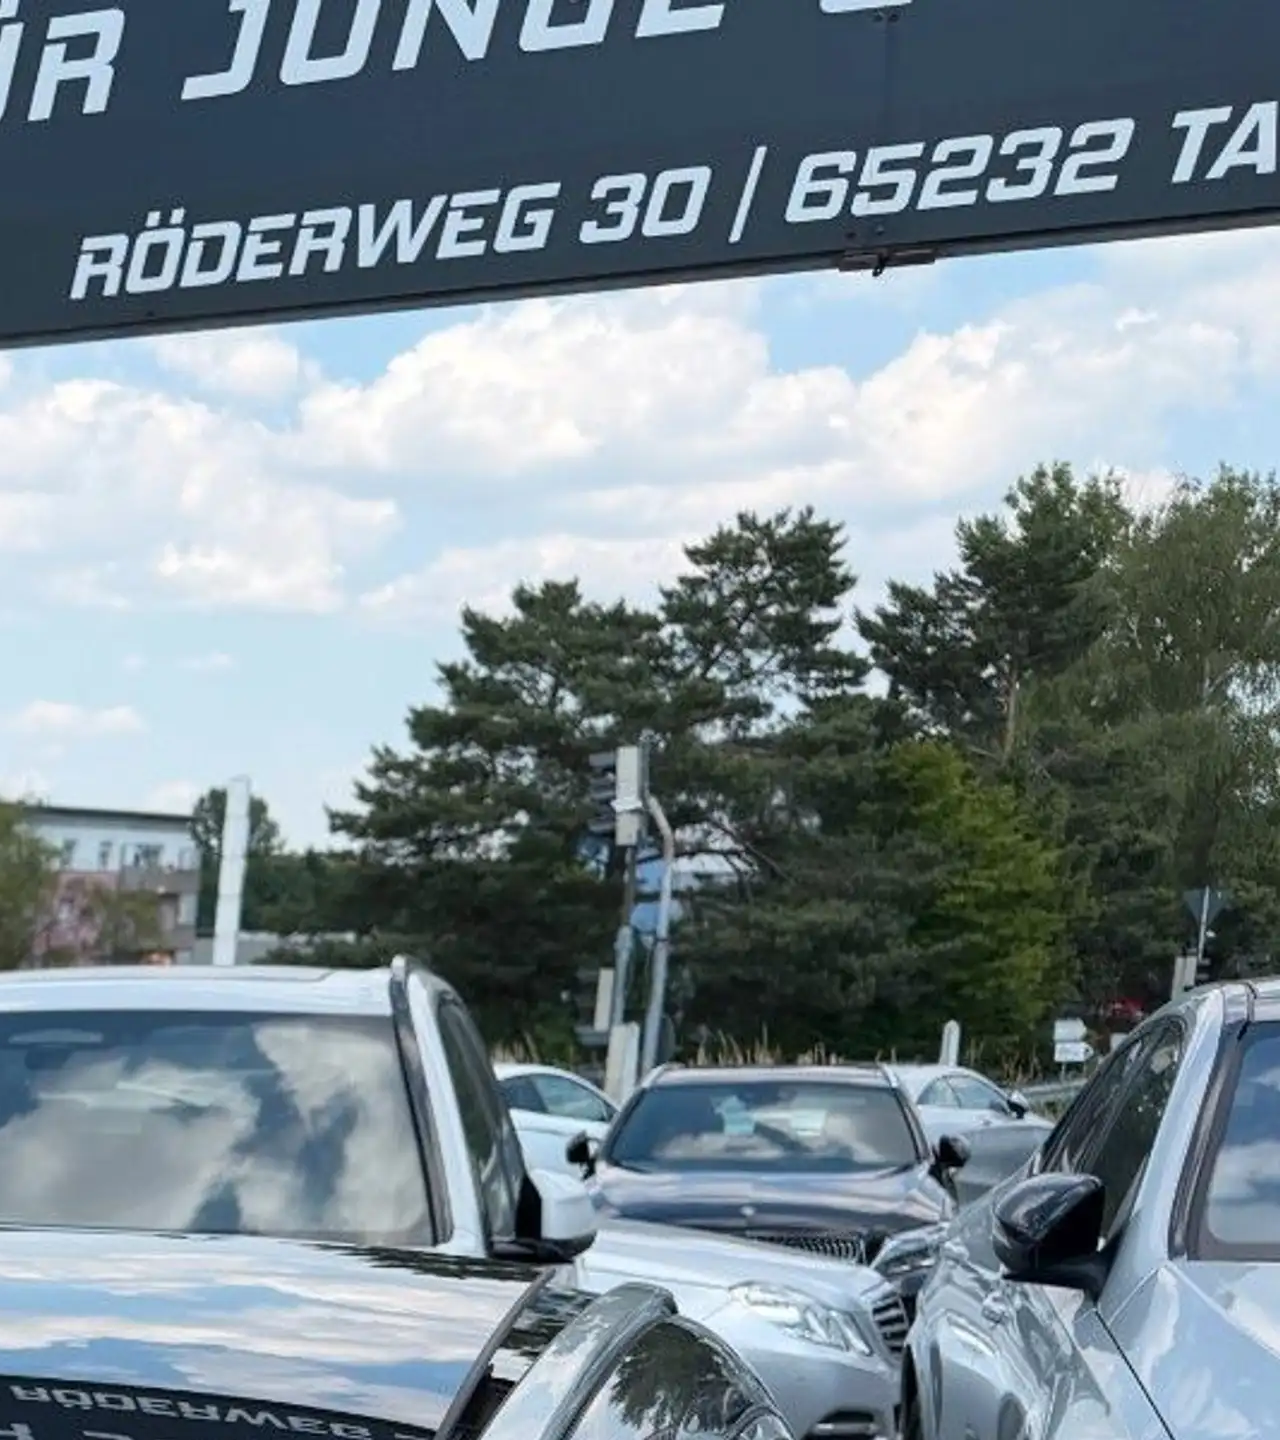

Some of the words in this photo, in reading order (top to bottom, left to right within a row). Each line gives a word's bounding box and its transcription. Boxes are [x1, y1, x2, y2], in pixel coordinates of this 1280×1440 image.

[70, 182, 562, 300] RÖDERWEG
[579, 165, 712, 244] 30
[784, 117, 1135, 223] 65232
[1171, 100, 1278, 183] TA
